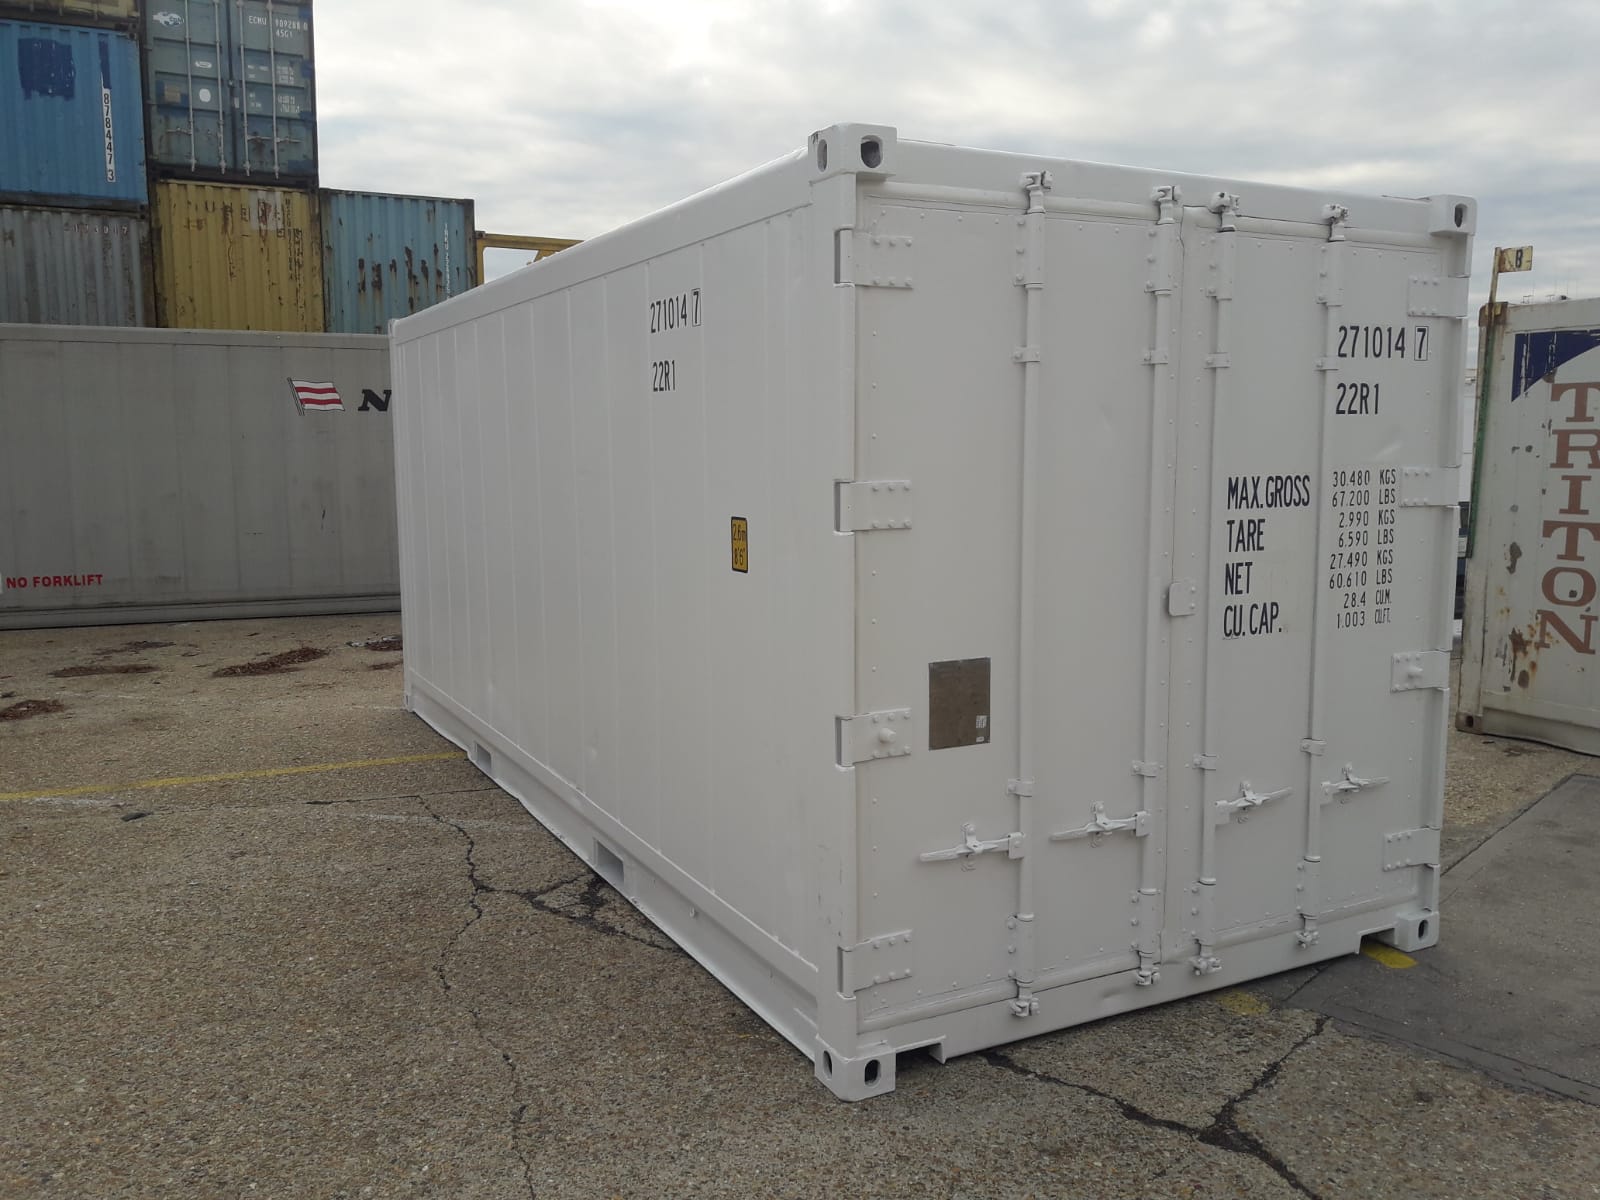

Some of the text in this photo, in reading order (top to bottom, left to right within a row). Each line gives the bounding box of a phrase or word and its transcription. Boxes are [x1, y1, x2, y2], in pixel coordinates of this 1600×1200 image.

[650, 290, 700, 333] 271014 7
[1337, 325, 1428, 360] 271014 7
[652, 359, 676, 392] 22R1
[1335, 382, 1380, 415] 22R1
[1332, 468, 1397, 488] 30.480 KGS
[1331, 488, 1396, 508] 67.200 LBS
[1338, 508, 1395, 529] 2.990 KGS
[1535, 381, 1600, 655] TRITON
[1226, 518, 1266, 553] TARE
[1338, 528, 1394, 548] 6.590 LBS
[1329, 548, 1394, 570] 27.490 KGS
[6, 573, 104, 589] NO FORKLIFT
[1224, 561, 1253, 596] NET
[1329, 568, 1393, 590] 60.610 LBS
[1343, 591, 1366, 609] 28.4
[1336, 610, 1366, 630] 1.003
